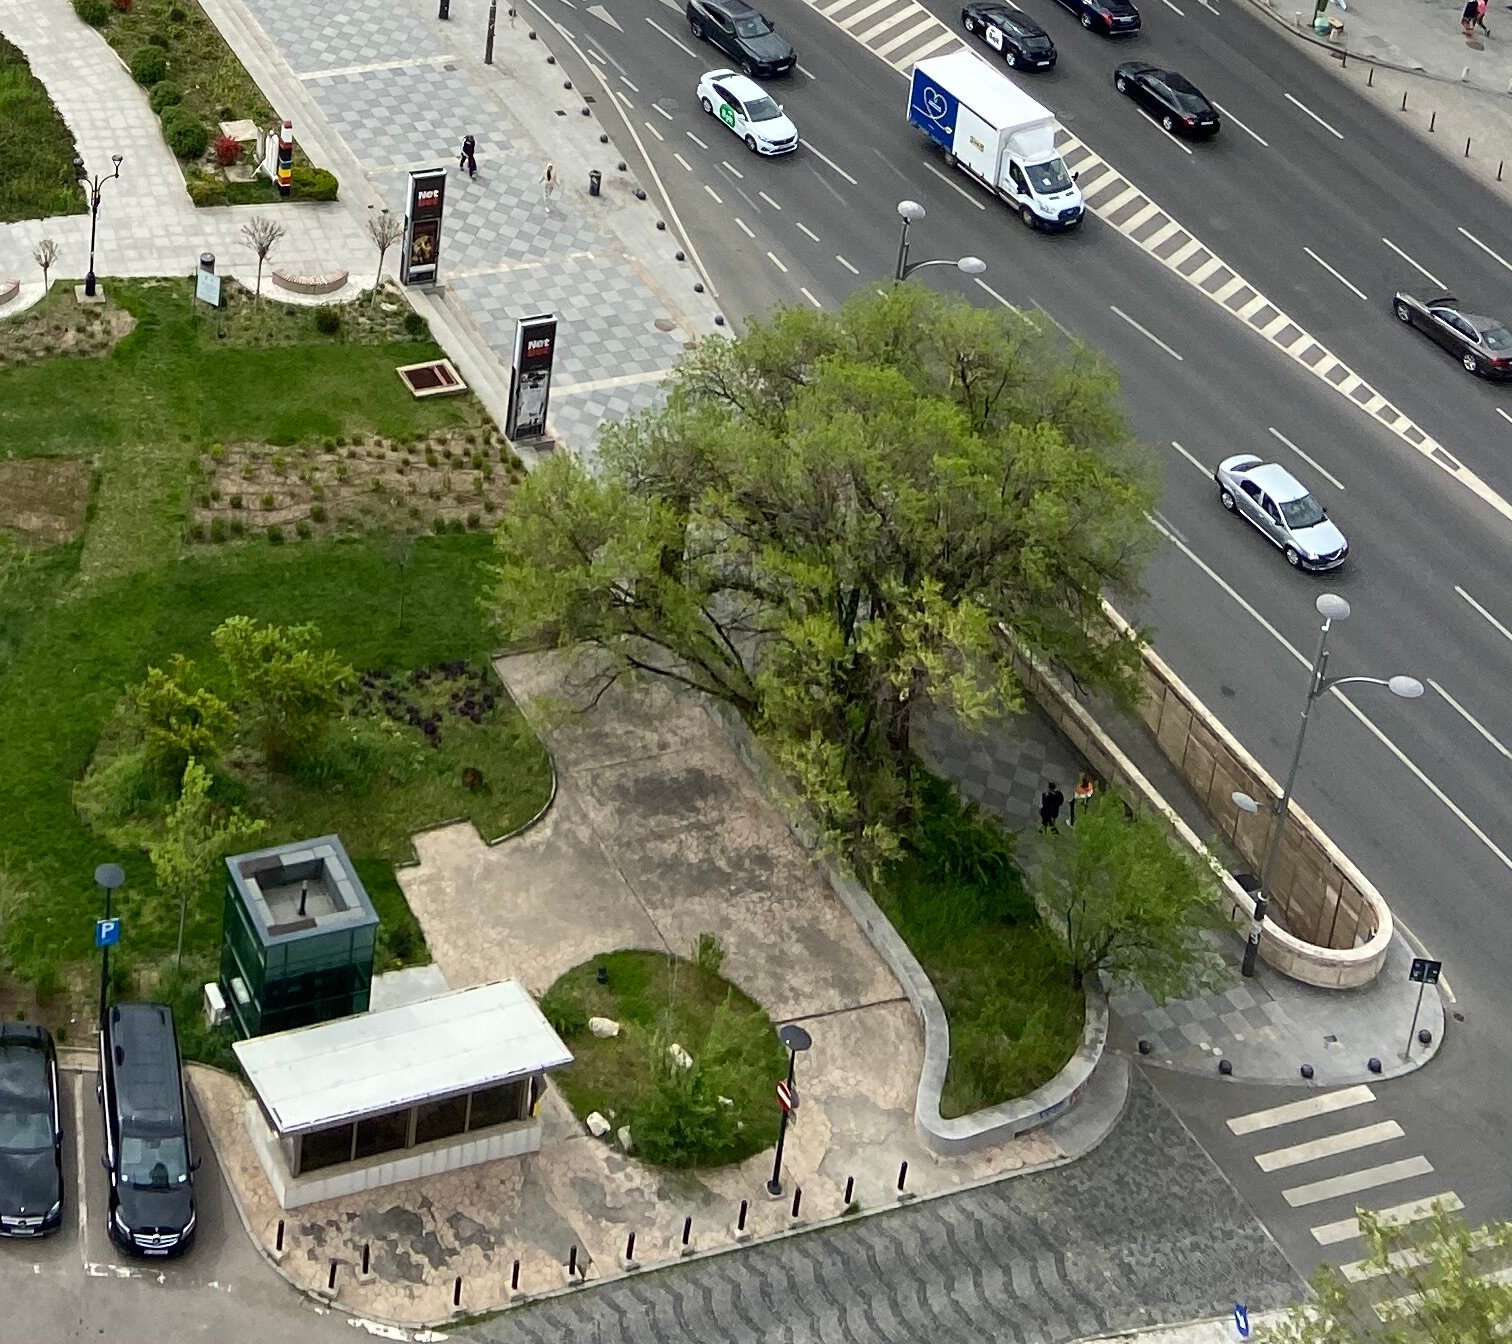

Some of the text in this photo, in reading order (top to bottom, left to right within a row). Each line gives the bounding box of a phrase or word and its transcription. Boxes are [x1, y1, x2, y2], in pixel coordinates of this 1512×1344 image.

[418, 189, 439, 200] Net
[528, 338, 550, 350] Net
[101, 922, 115, 939] P
